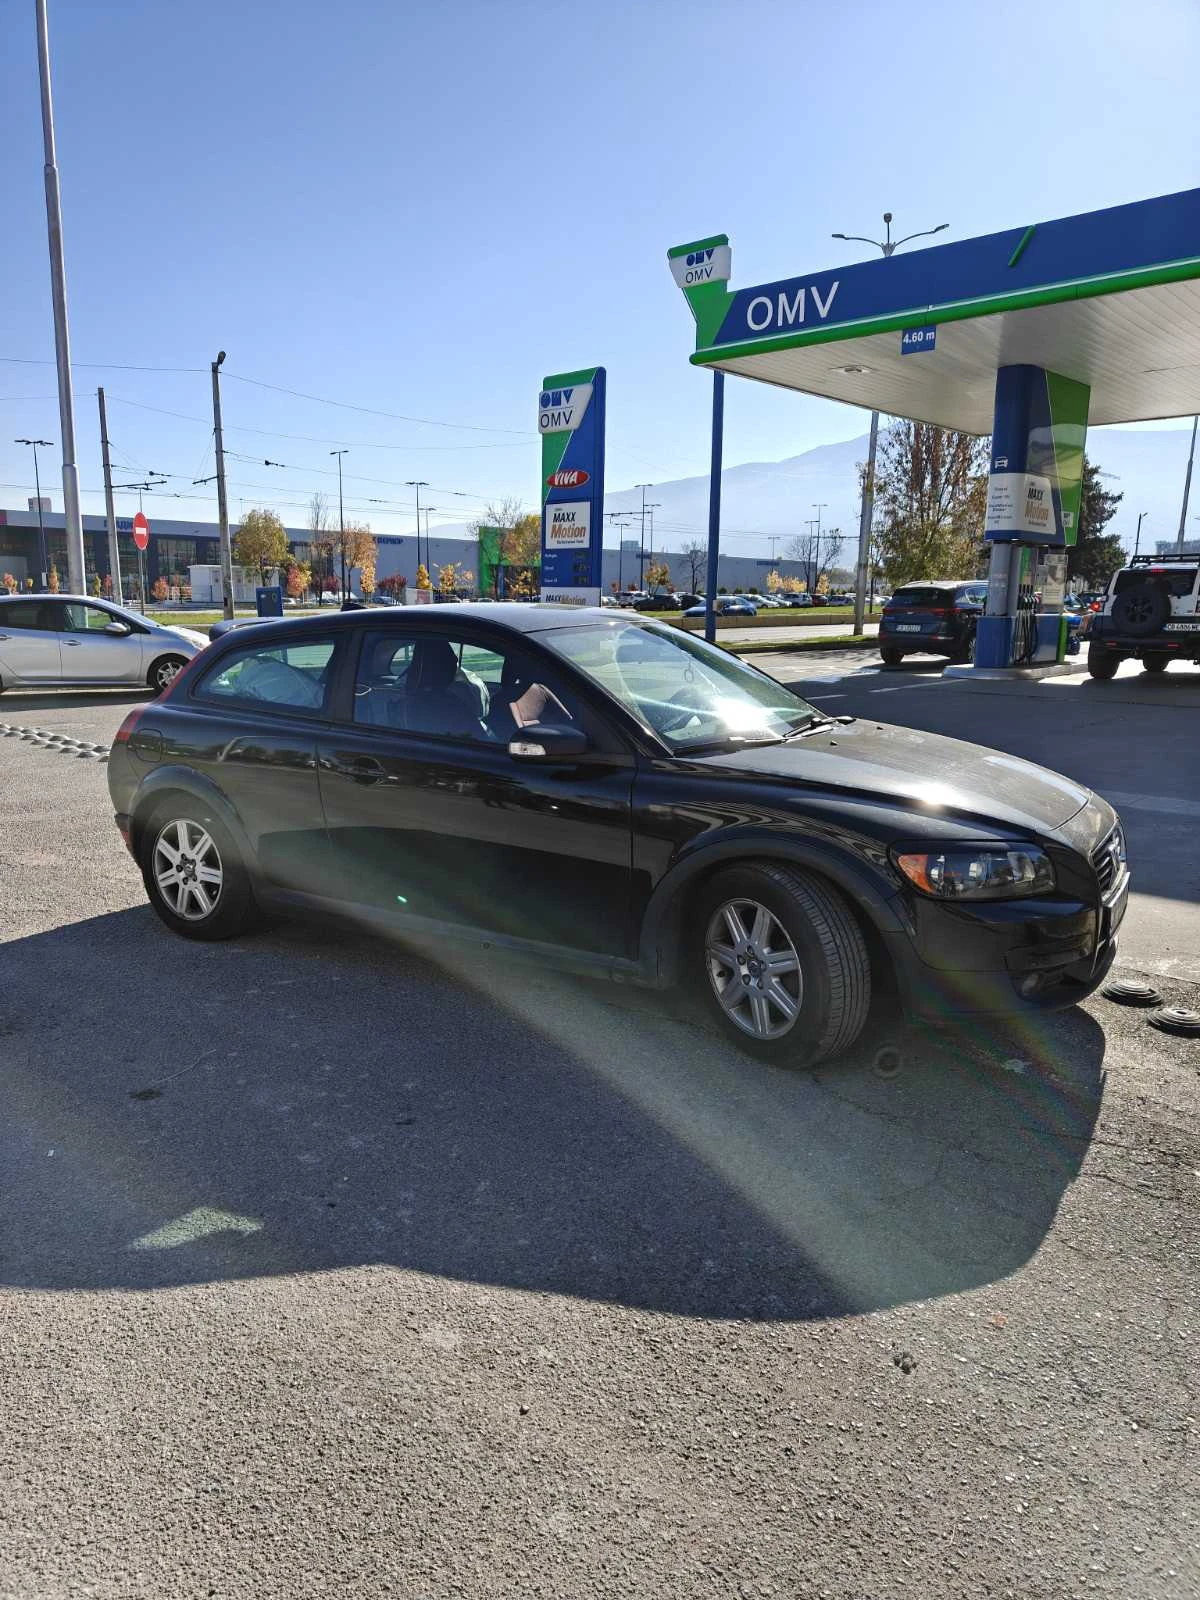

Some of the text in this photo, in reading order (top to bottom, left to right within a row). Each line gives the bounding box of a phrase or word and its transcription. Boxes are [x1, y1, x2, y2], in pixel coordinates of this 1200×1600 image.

[685, 266, 713, 284] OMV
[746, 281, 839, 331] OMV
[903, 331, 935, 345] 4.60 m
[541, 410, 573, 428] OMV
[554, 471, 578, 486] VIVA
[1027, 487, 1043, 501] MAXX
[552, 511, 576, 523] MAXX
[550, 523, 586, 540] Motion
